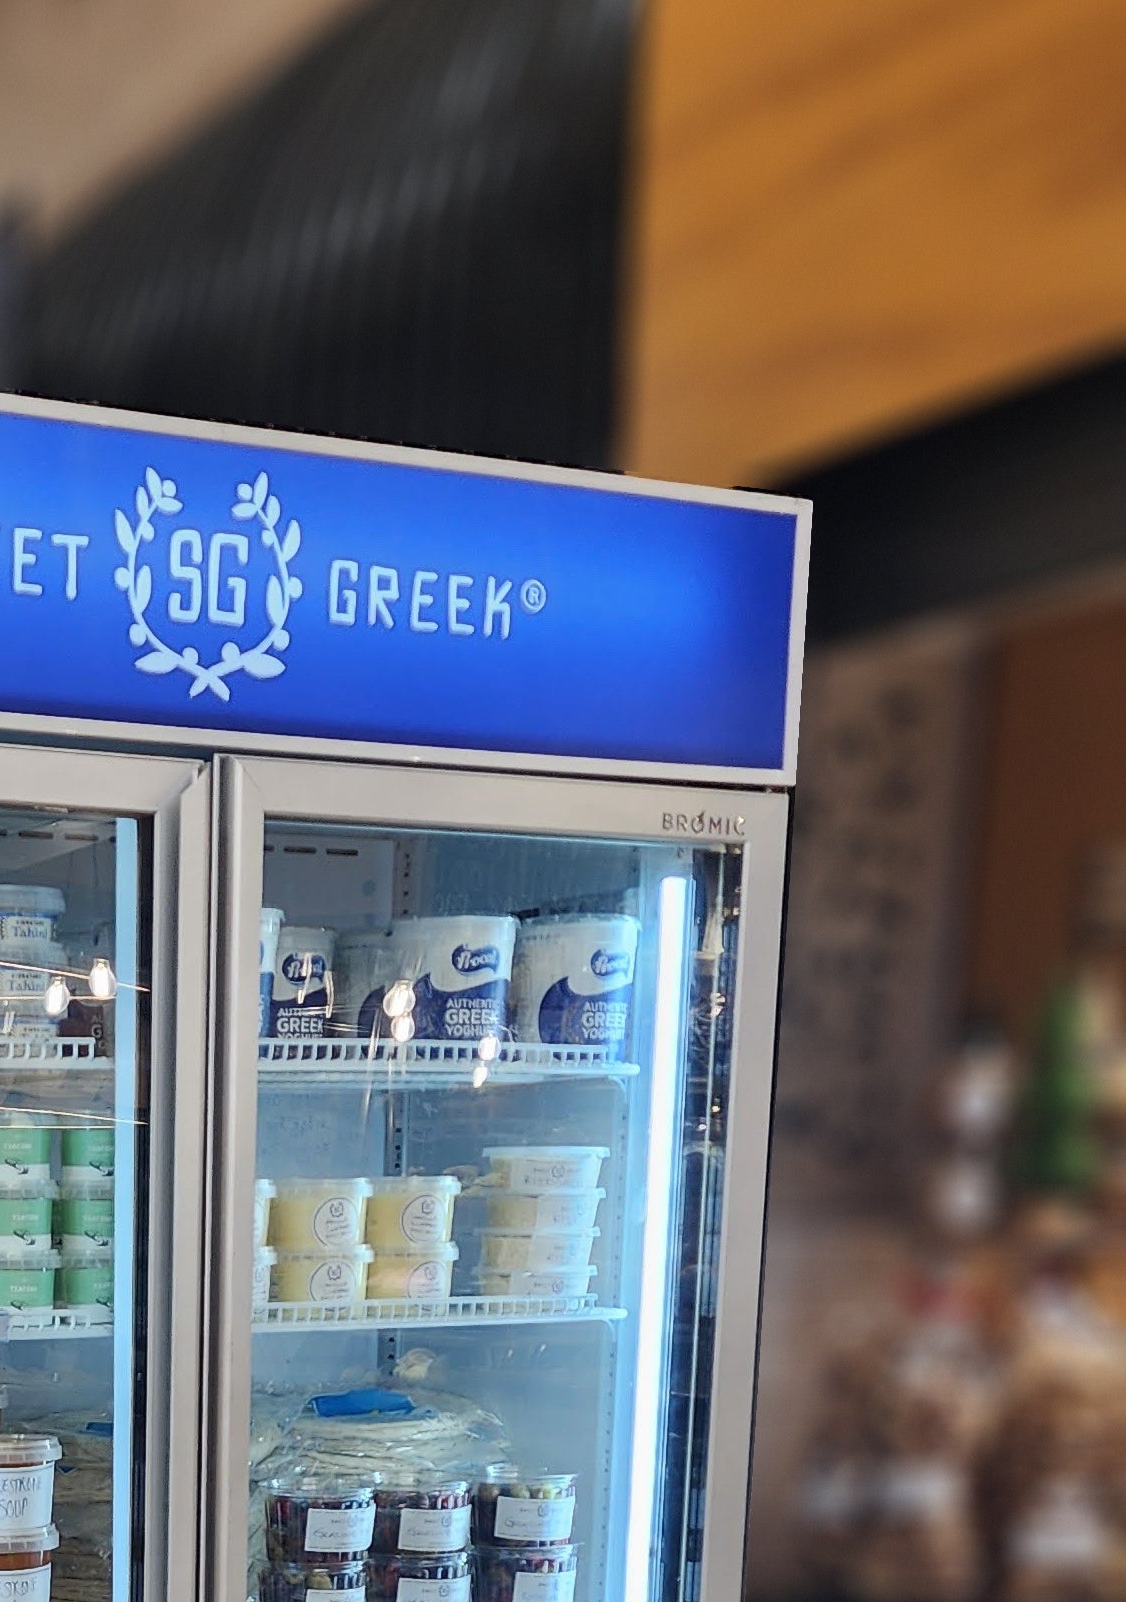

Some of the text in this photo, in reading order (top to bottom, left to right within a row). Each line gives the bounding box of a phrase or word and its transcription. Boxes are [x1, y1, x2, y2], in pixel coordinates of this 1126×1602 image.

[167, 527, 249, 627] SG
[661, 810, 746, 836] BROMIC
[12, 925, 48, 939] Tahini
[276, 1017, 324, 1033] GREEK
